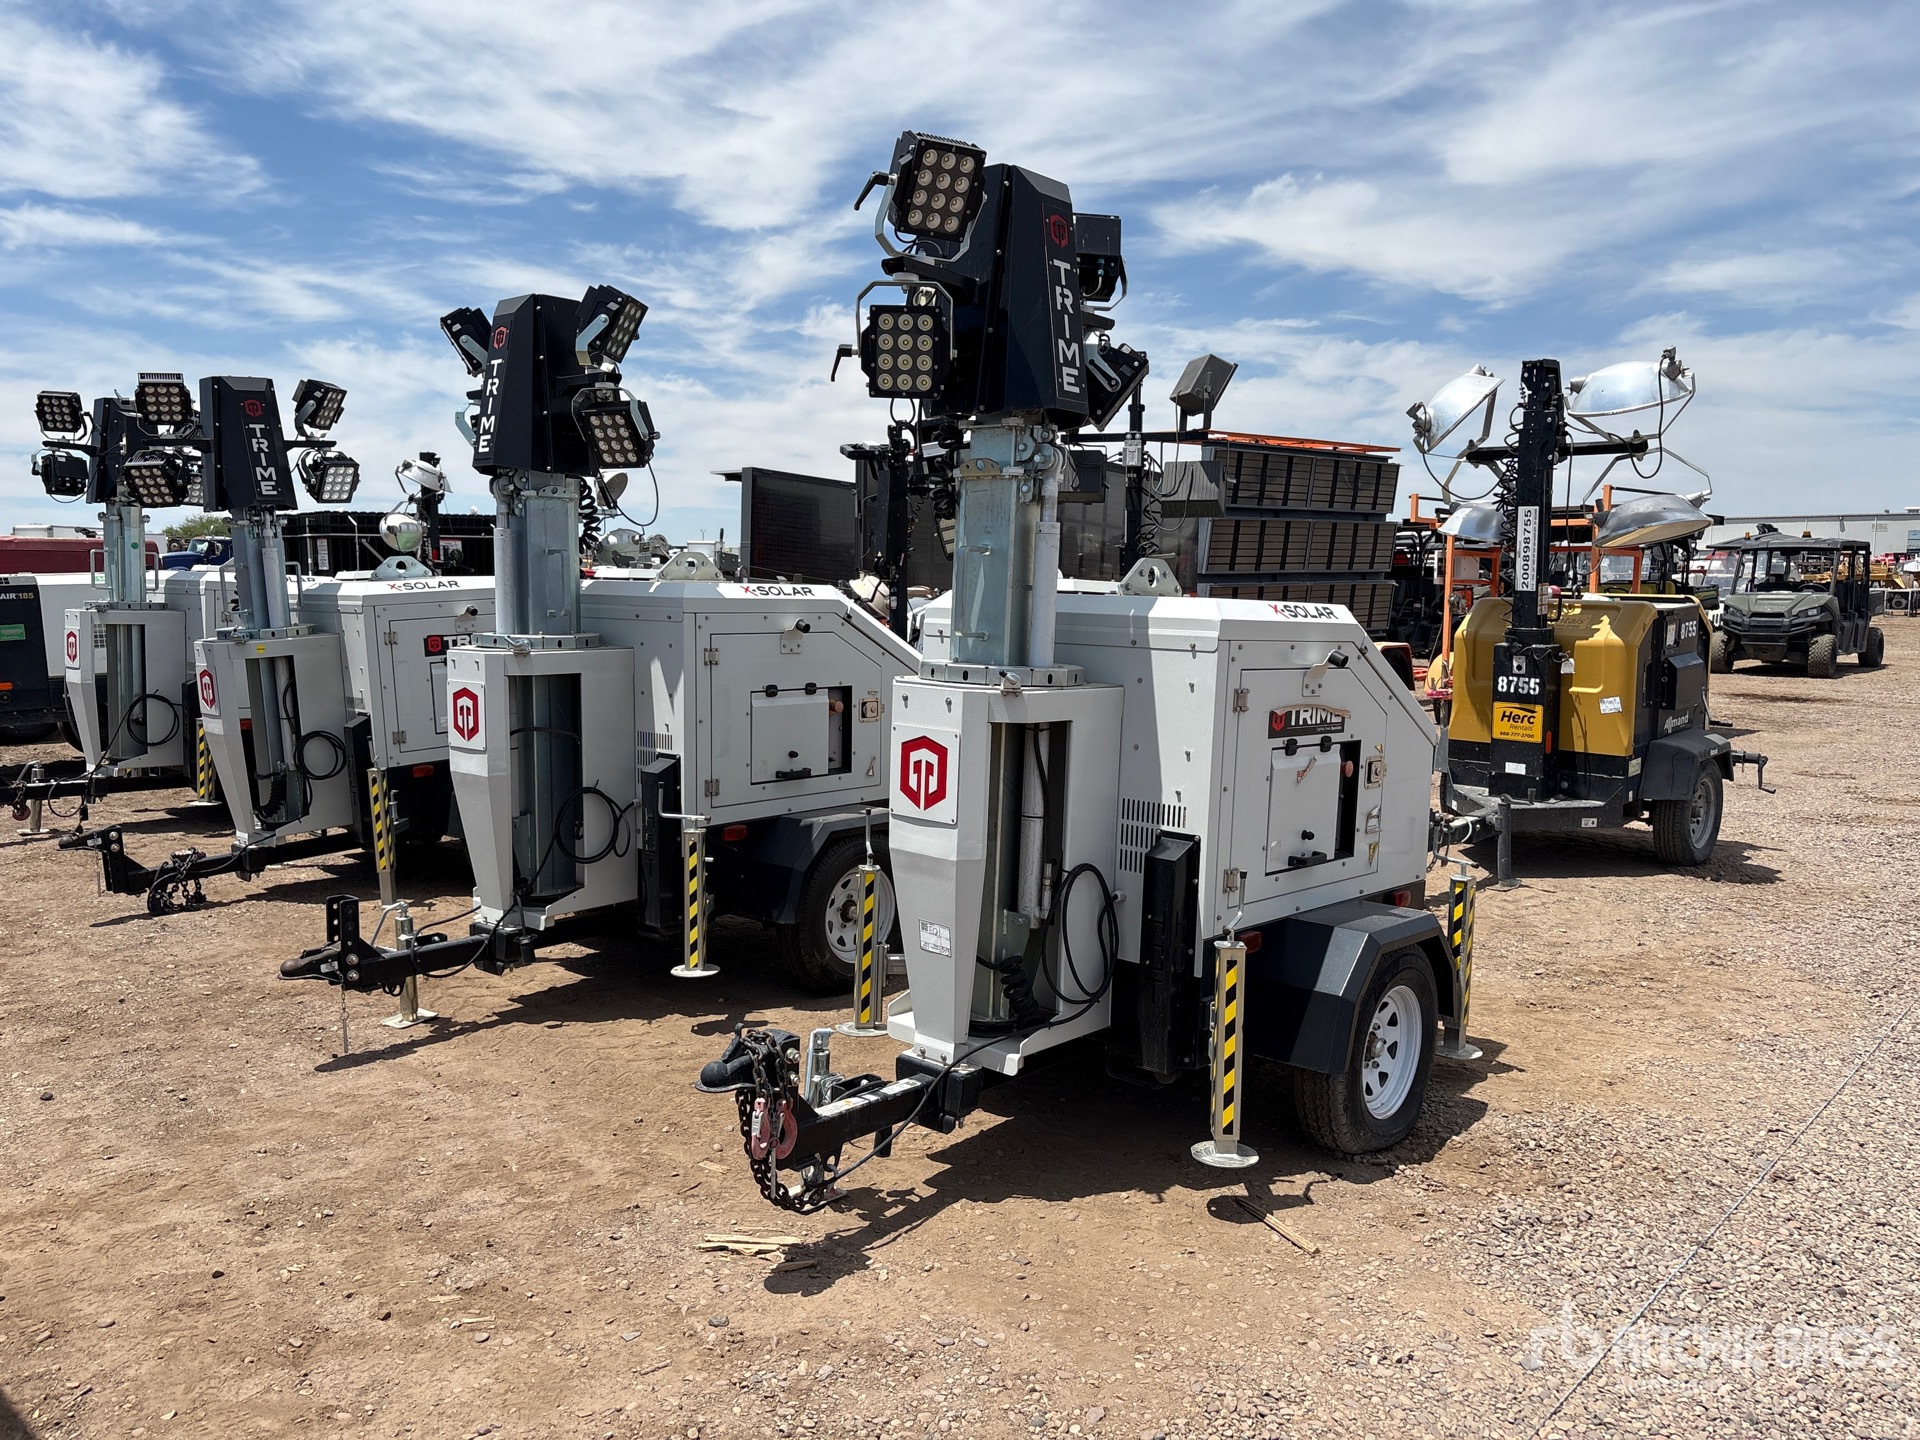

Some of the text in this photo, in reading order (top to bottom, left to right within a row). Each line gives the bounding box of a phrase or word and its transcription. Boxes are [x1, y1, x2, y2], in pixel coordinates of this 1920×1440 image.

[1053, 258, 1081, 394] TRIME
[478, 358, 503, 453] TRIME
[248, 423, 278, 495] TRIME
[1521, 509, 1532, 590] 200898755
[386, 580, 460, 592] X-SOLAR
[740, 585, 815, 597] X-SOLAR
[18, 592, 35, 600] 185
[1268, 603, 1339, 620] X-SOLAR
[1680, 620, 1697, 640] 8755
[1497, 675, 1540, 696] 8755
[1500, 710, 1537, 725] Herc
[1663, 710, 1690, 734] Allmand
[1499, 730, 1535, 739] 888-777-2700
[1509, 723, 1534, 732] Rentals
